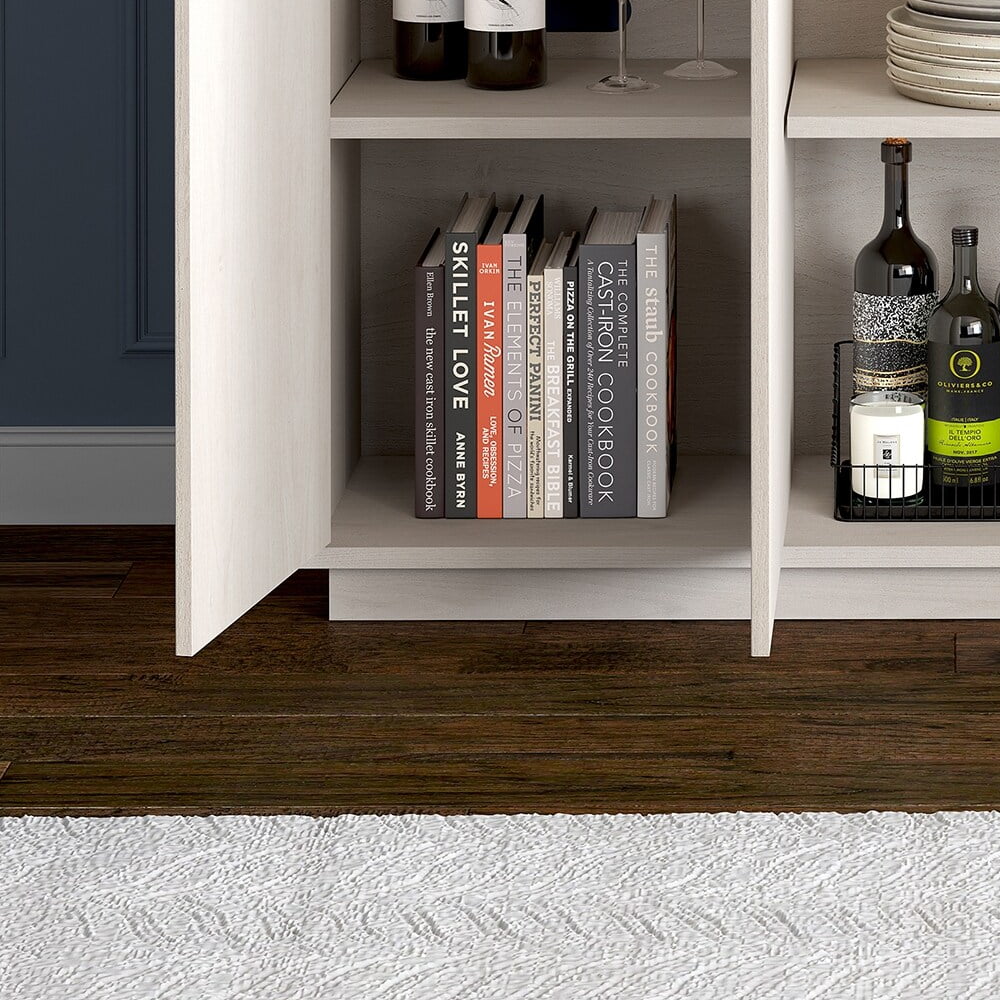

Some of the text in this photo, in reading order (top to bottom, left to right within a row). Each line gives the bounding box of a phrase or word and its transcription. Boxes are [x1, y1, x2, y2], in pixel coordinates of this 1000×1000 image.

[426, 272, 435, 317] Ellen Brown
[507, 256, 522, 292] THE
[566, 281, 575, 312] PIZZA
[586, 267, 594, 305] Tantalizing
[452, 241, 469, 409] SKILLET LOVE
[566, 314, 575, 329] ON
[617, 260, 628, 368] THE COMPLETE
[483, 301, 502, 398] IVAN Ramen
[507, 301, 522, 400] ELEMENTS
[529, 280, 541, 421] PERFECT PANINI
[566, 332, 575, 352] THE
[586, 341, 594, 349] of
[645, 245, 664, 453] THE staub COOKBOOK
[566, 355, 575, 386] GRILL
[586, 383, 594, 408] Recipes
[597, 261, 614, 503] CAST-IRON COOKBOOK
[425, 327, 437, 511] the new cast iron skillet cookbook
[507, 408, 522, 434] OF
[546, 341, 560, 511] THE BREAKFAST BIBLE
[586, 409, 594, 419] for
[456, 432, 466, 508] ANNE BYRN
[482, 427, 490, 479] AND RECIPES
[489, 416, 497, 487] LOVE, OBSESSION,
[507, 443, 522, 498] PIZZA
